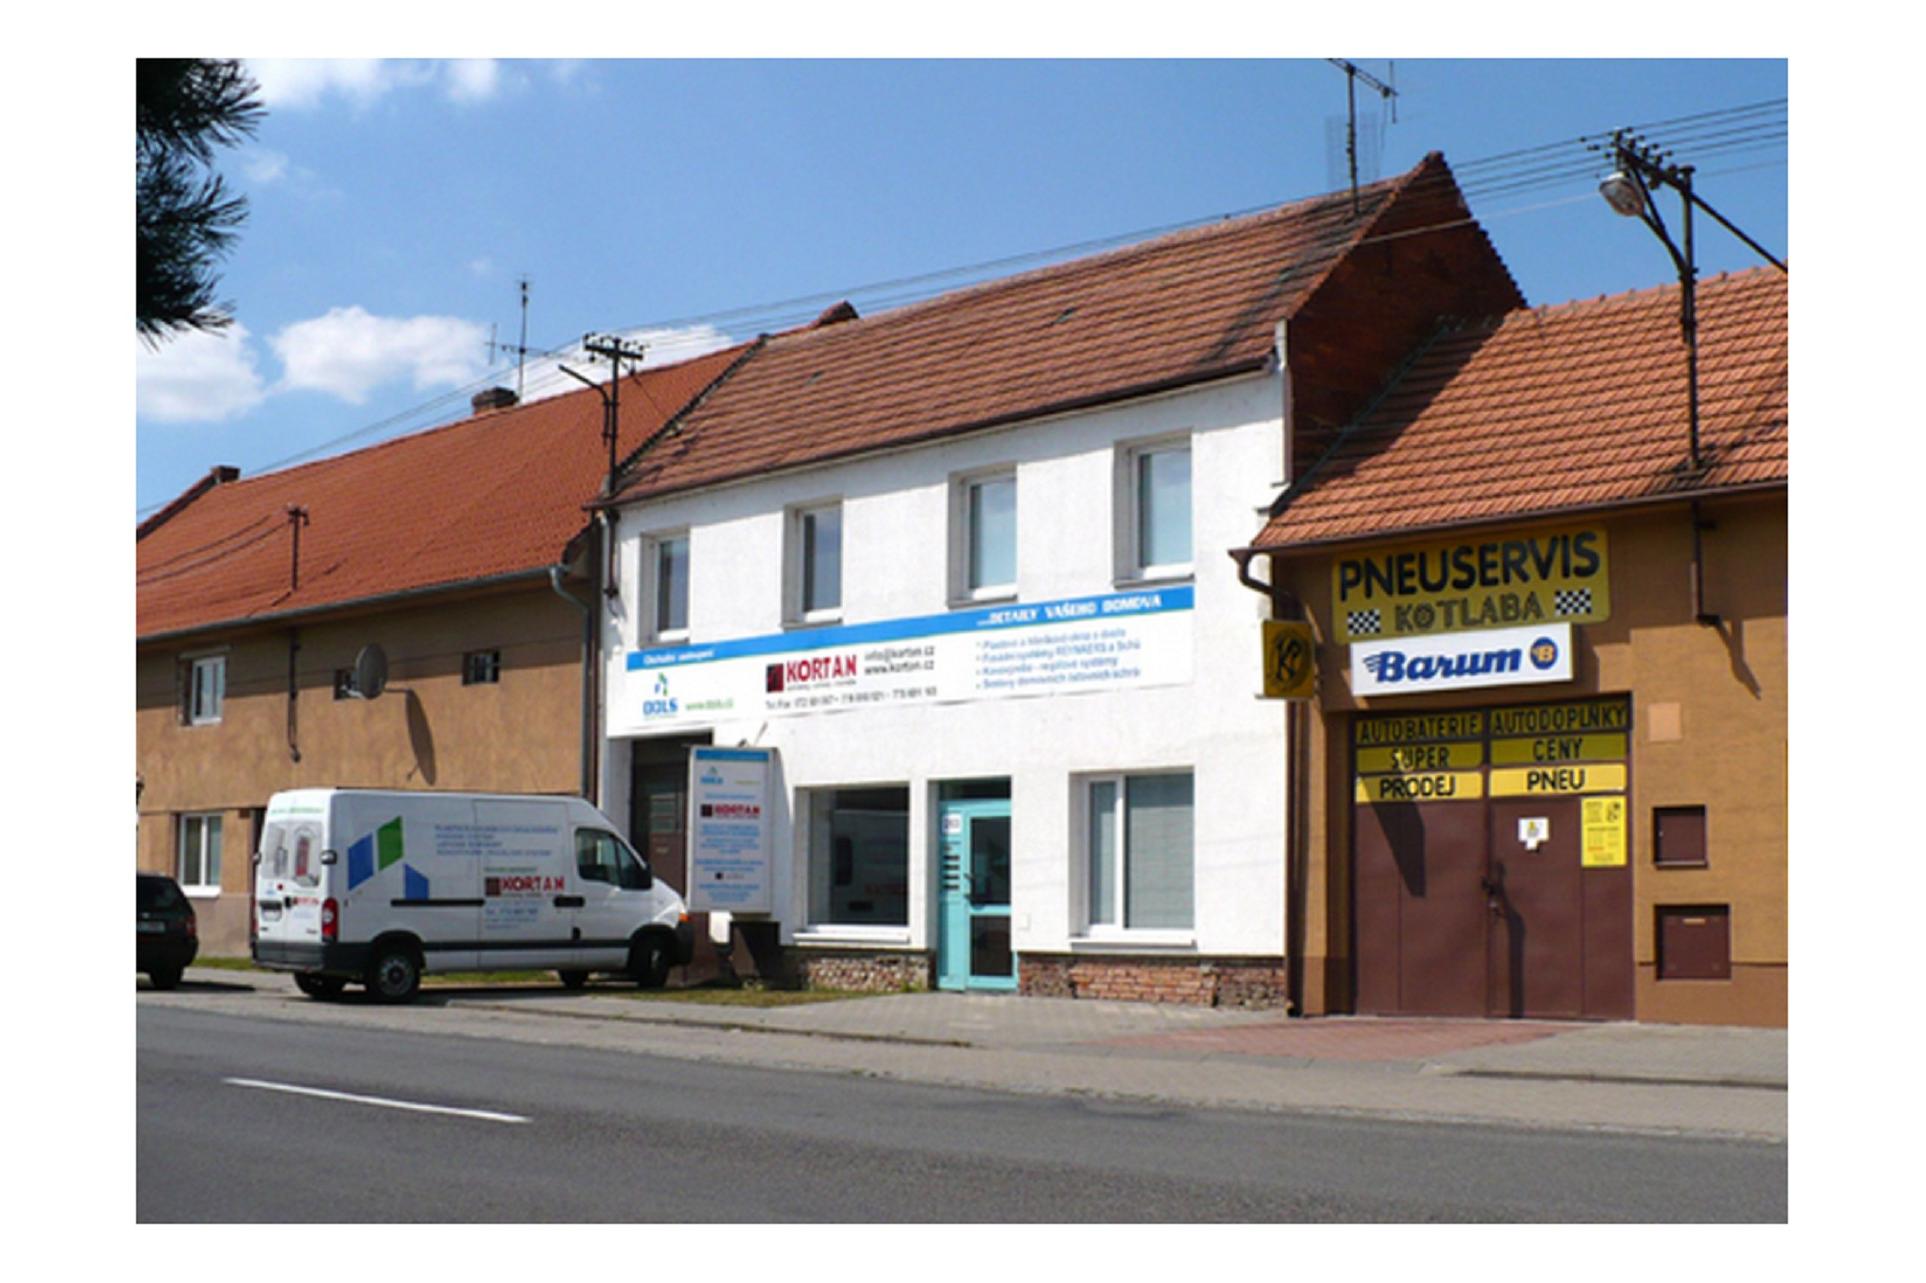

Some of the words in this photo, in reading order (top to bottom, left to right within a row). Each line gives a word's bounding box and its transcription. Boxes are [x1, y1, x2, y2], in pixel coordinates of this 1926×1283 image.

[1340, 531, 1599, 601] PNEUSERVIS
[1103, 595, 1162, 613] DOMOVA
[1395, 592, 1544, 631] KOTLABA
[786, 654, 857, 683] KORTAN
[1363, 648, 1522, 683] Barum
[1360, 713, 1479, 743] AUTOBATERIE
[1392, 746, 1450, 770] SUPER
[1533, 738, 1582, 761] CENY
[1379, 775, 1455, 798] PRODEJ
[1526, 768, 1585, 791] PNEU
[501, 875, 565, 892] KORTAN
